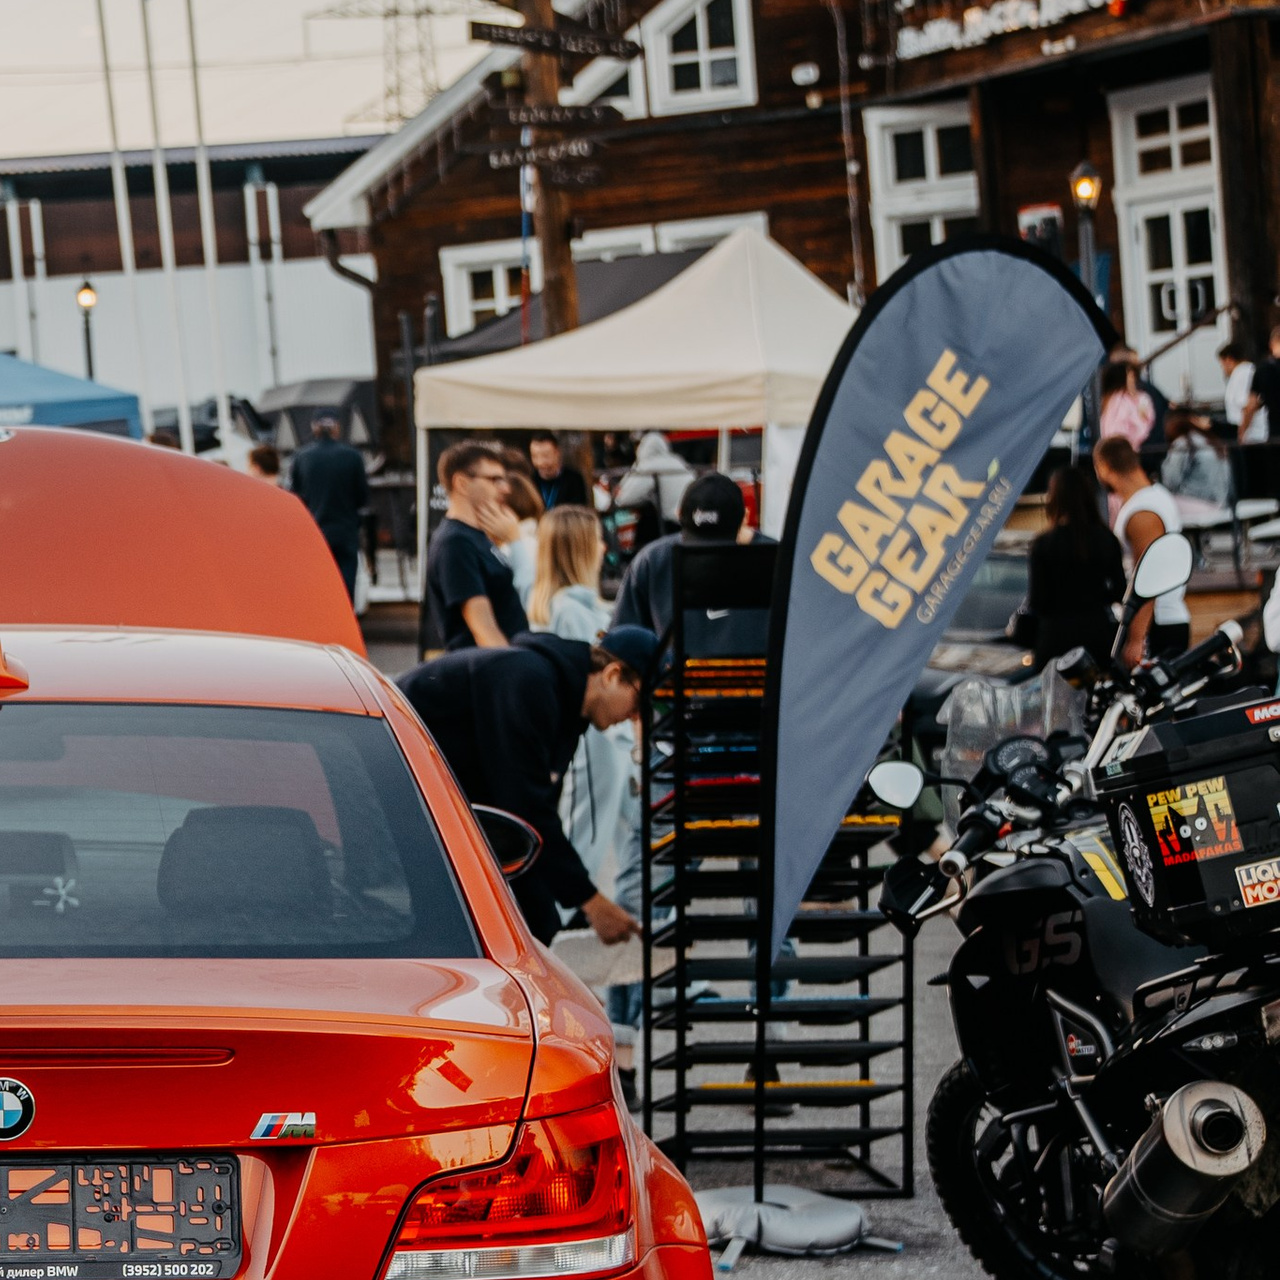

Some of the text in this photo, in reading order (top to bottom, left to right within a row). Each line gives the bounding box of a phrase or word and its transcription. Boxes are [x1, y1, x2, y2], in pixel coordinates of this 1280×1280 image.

[809, 347, 991, 595] GARAGE
[1146, 776, 1225, 807] PEW PEW
[1163, 840, 1242, 867] MADAFAKAS
[1245, 880, 1280, 903] MO
[1001, 910, 1083, 975] GS
[6, 1268, 44, 1279] дилер
[46, 1266, 78, 1277] BMW
[122, 1263, 214, 1277] (3952) 500 202
